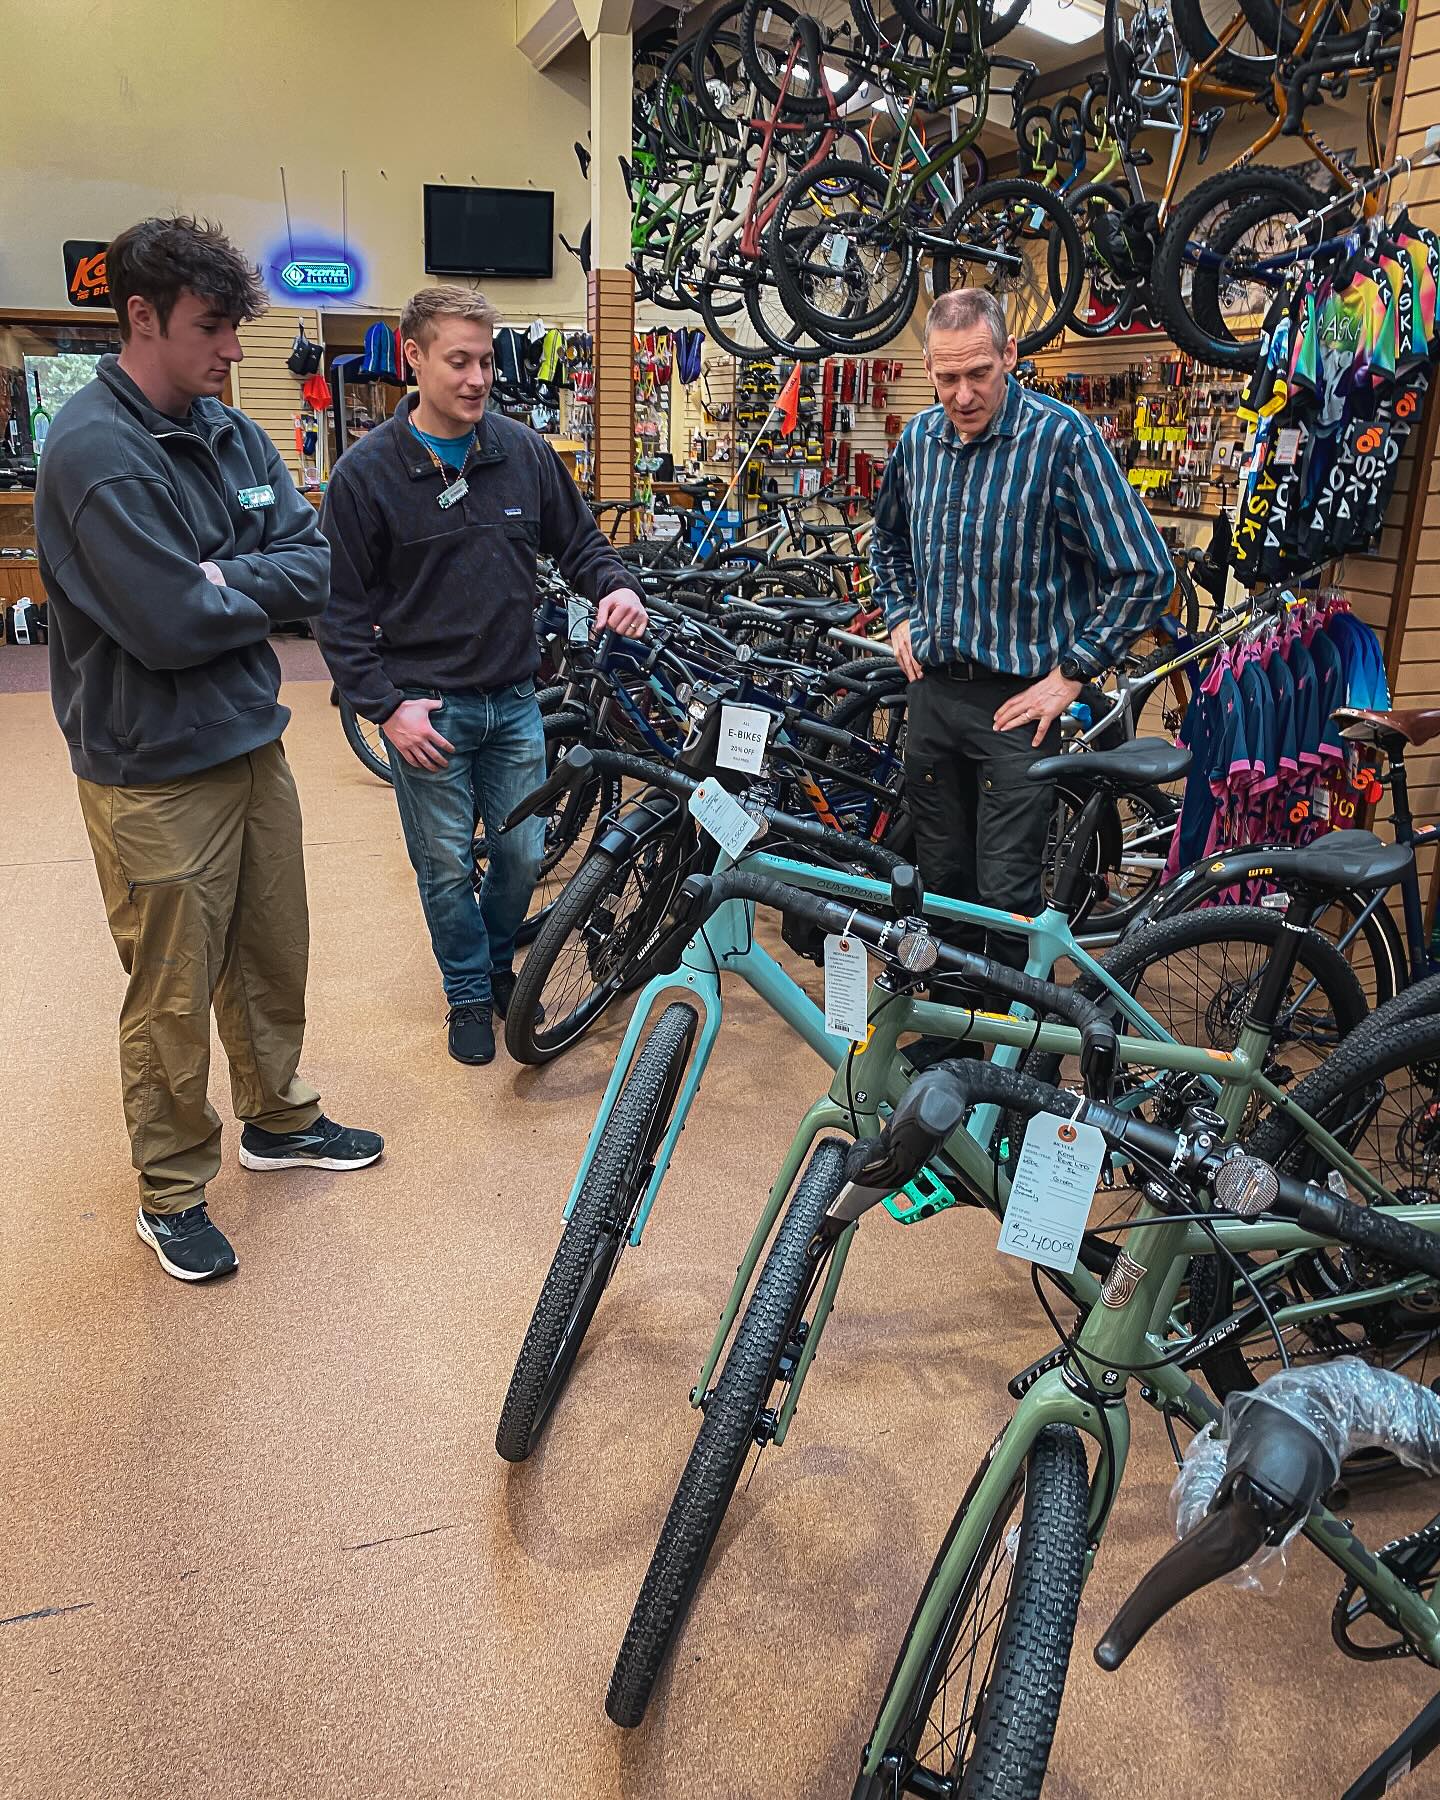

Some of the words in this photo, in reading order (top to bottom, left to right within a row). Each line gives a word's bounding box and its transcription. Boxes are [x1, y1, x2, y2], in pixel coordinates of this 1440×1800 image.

[741, 619, 782, 632] MAXXIS
[728, 728, 762, 743] E-BIKES
[730, 745, 743, 753] 20%
[743, 747, 755, 755] OFF
[1248, 867, 1273, 877] WTB
[636, 930, 660, 961] SRAM
[1105, 1371, 1118, 1381] 56
